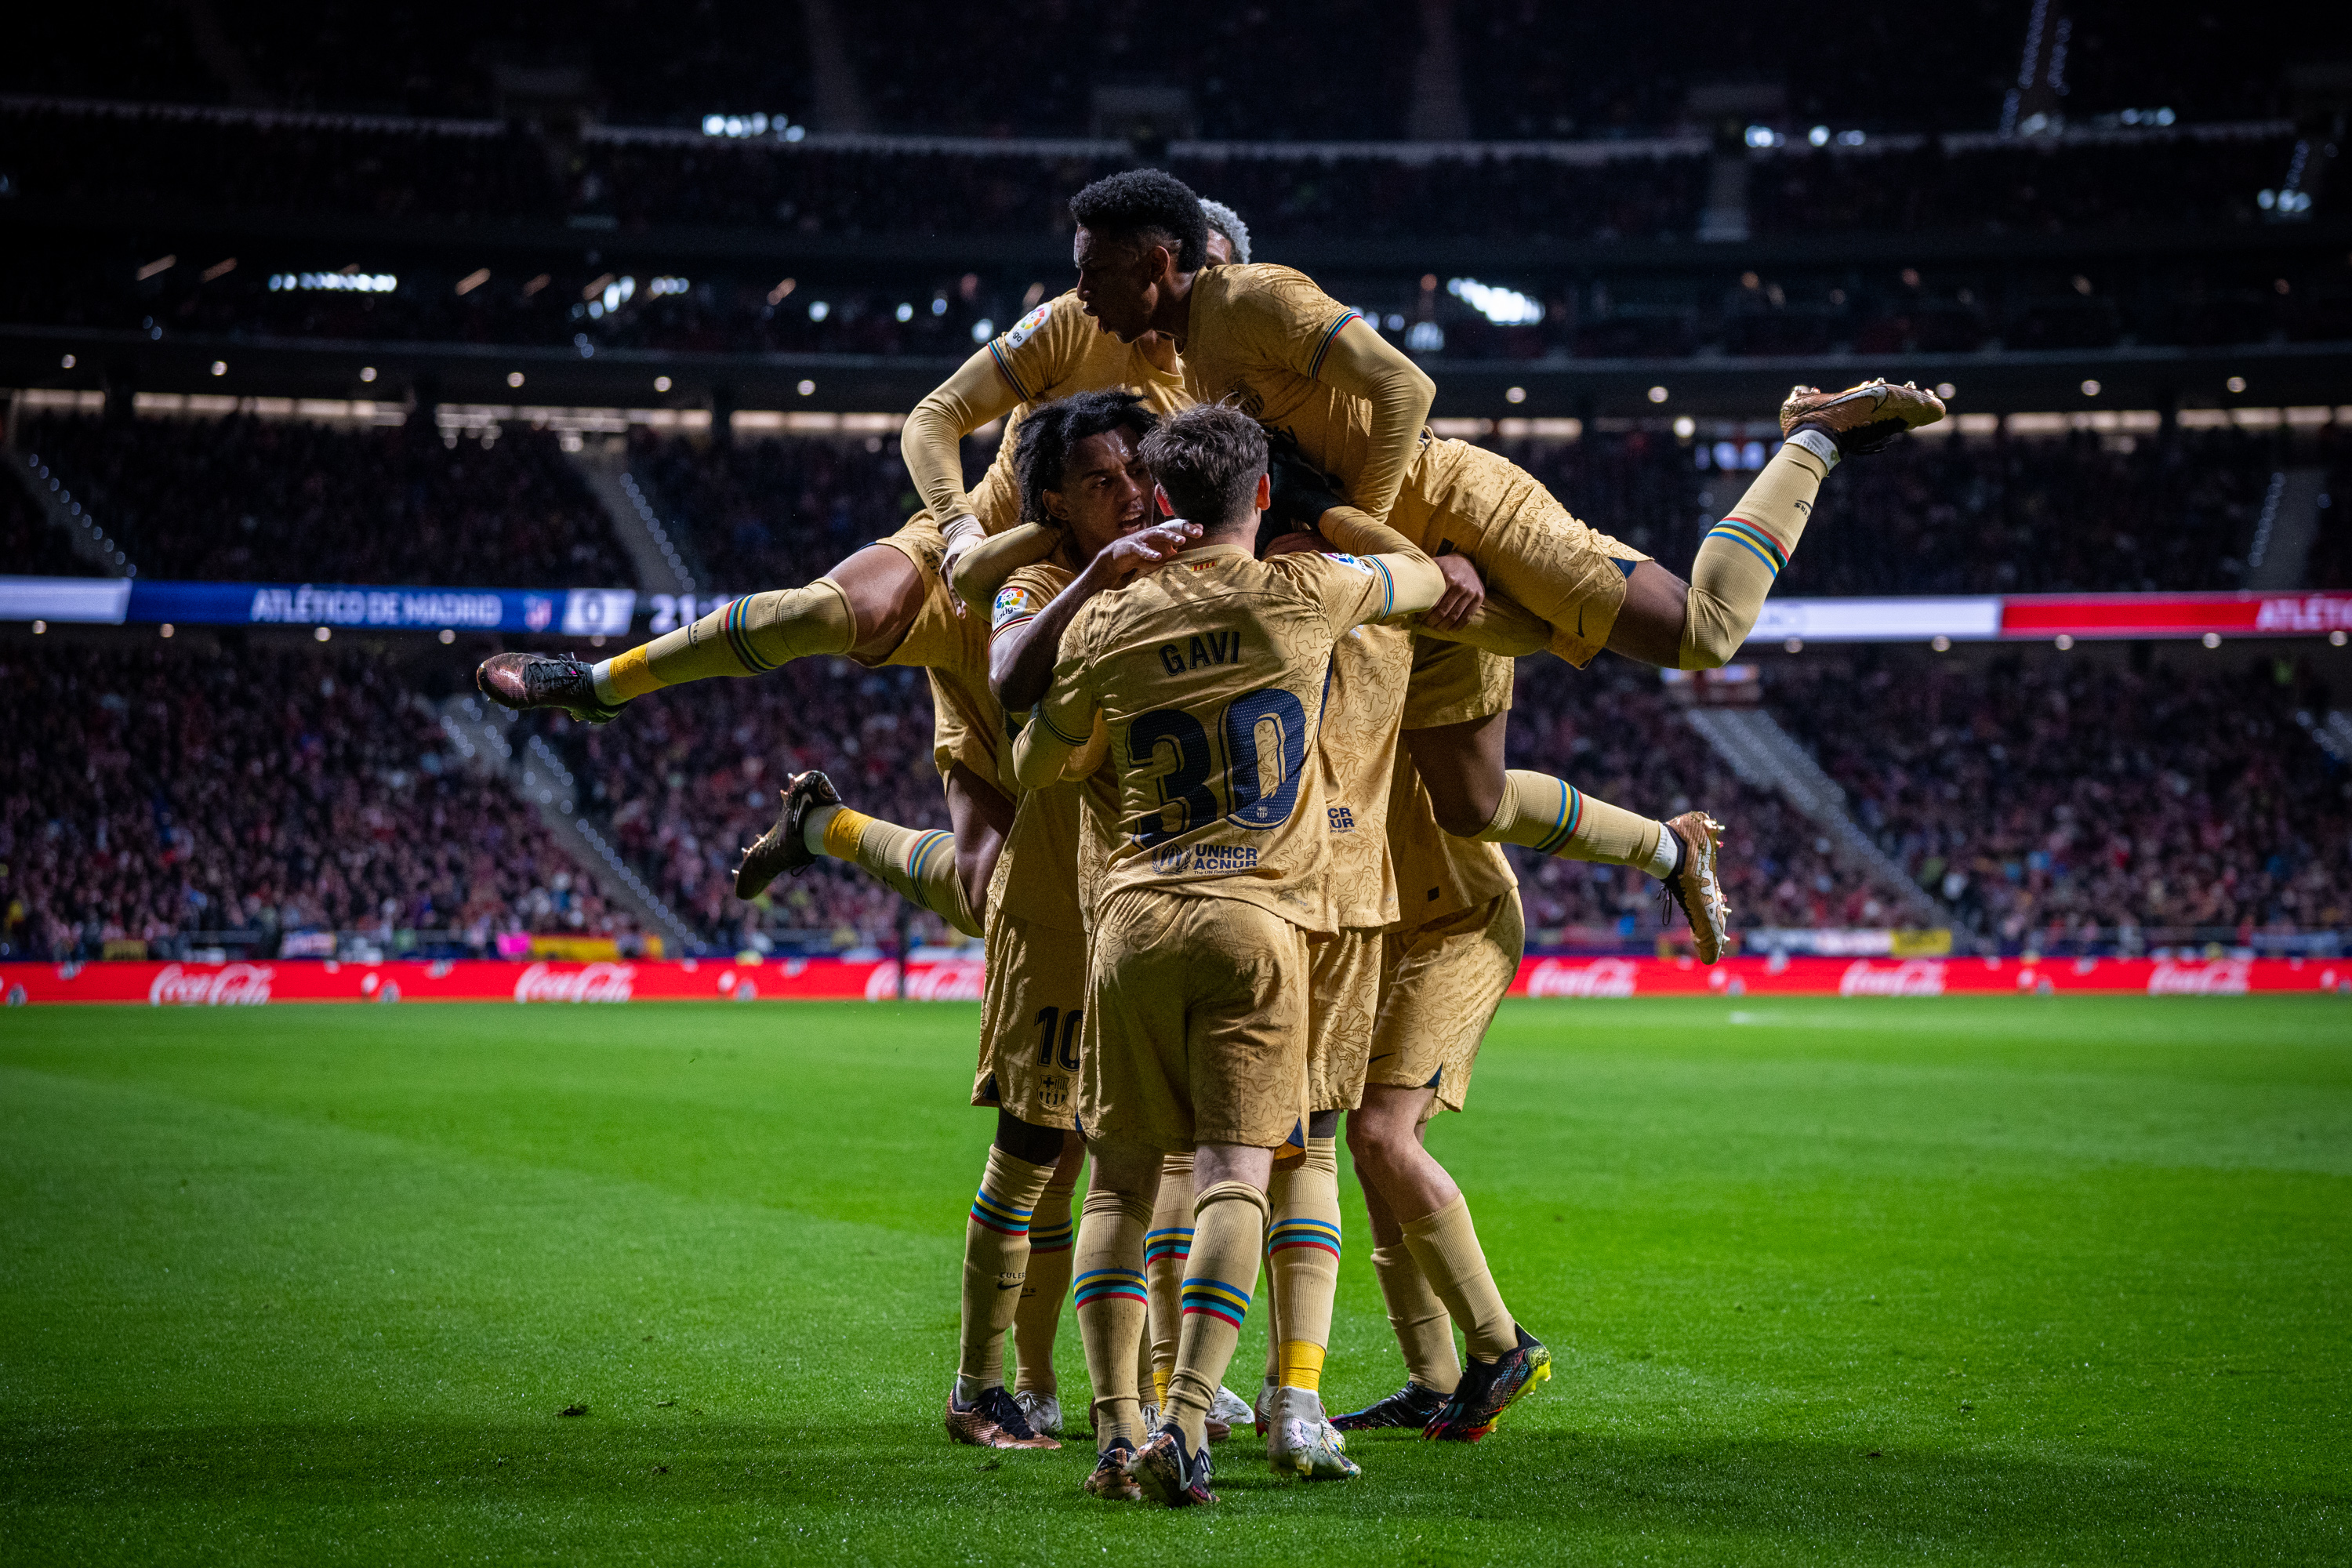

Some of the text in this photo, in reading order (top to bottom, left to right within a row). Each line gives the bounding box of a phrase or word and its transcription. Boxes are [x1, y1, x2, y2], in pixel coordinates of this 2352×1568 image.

[250, 583, 503, 626] ATLÉTICO DE MADRID
[1159, 631, 1240, 677] GAVI
[1124, 688, 1307, 852] 30
[1193, 858, 1258, 870] ACNUR
[1195, 844, 1258, 860] UNHCR
[1034, 1006, 1083, 1072] 10
